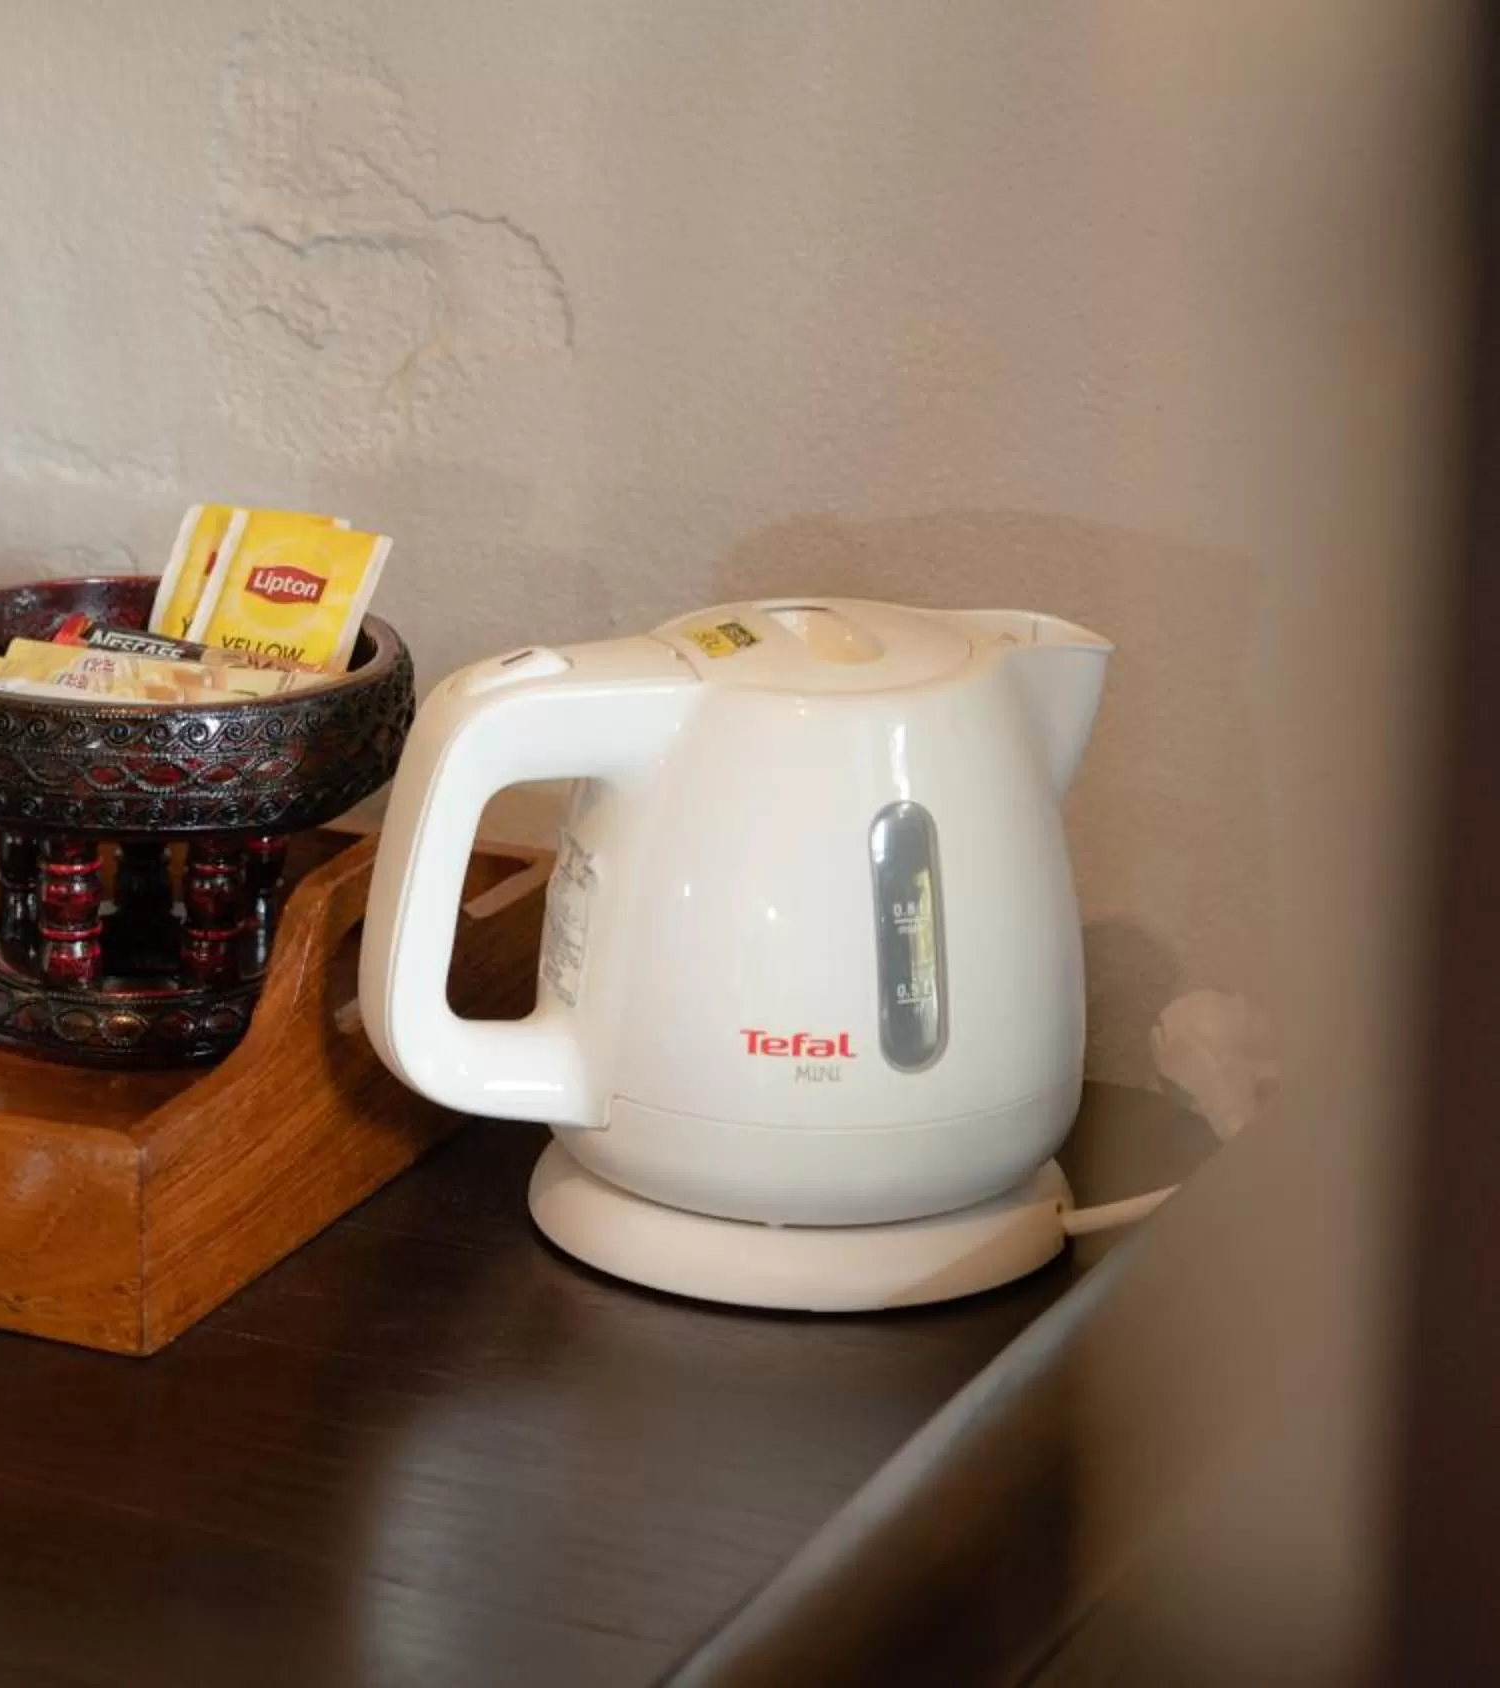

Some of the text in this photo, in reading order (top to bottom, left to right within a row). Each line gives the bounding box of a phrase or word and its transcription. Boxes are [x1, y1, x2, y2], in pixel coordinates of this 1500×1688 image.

[252, 569, 319, 598] Lipton
[221, 634, 305, 661] YELLOW
[739, 1028, 858, 1058] Tefal
